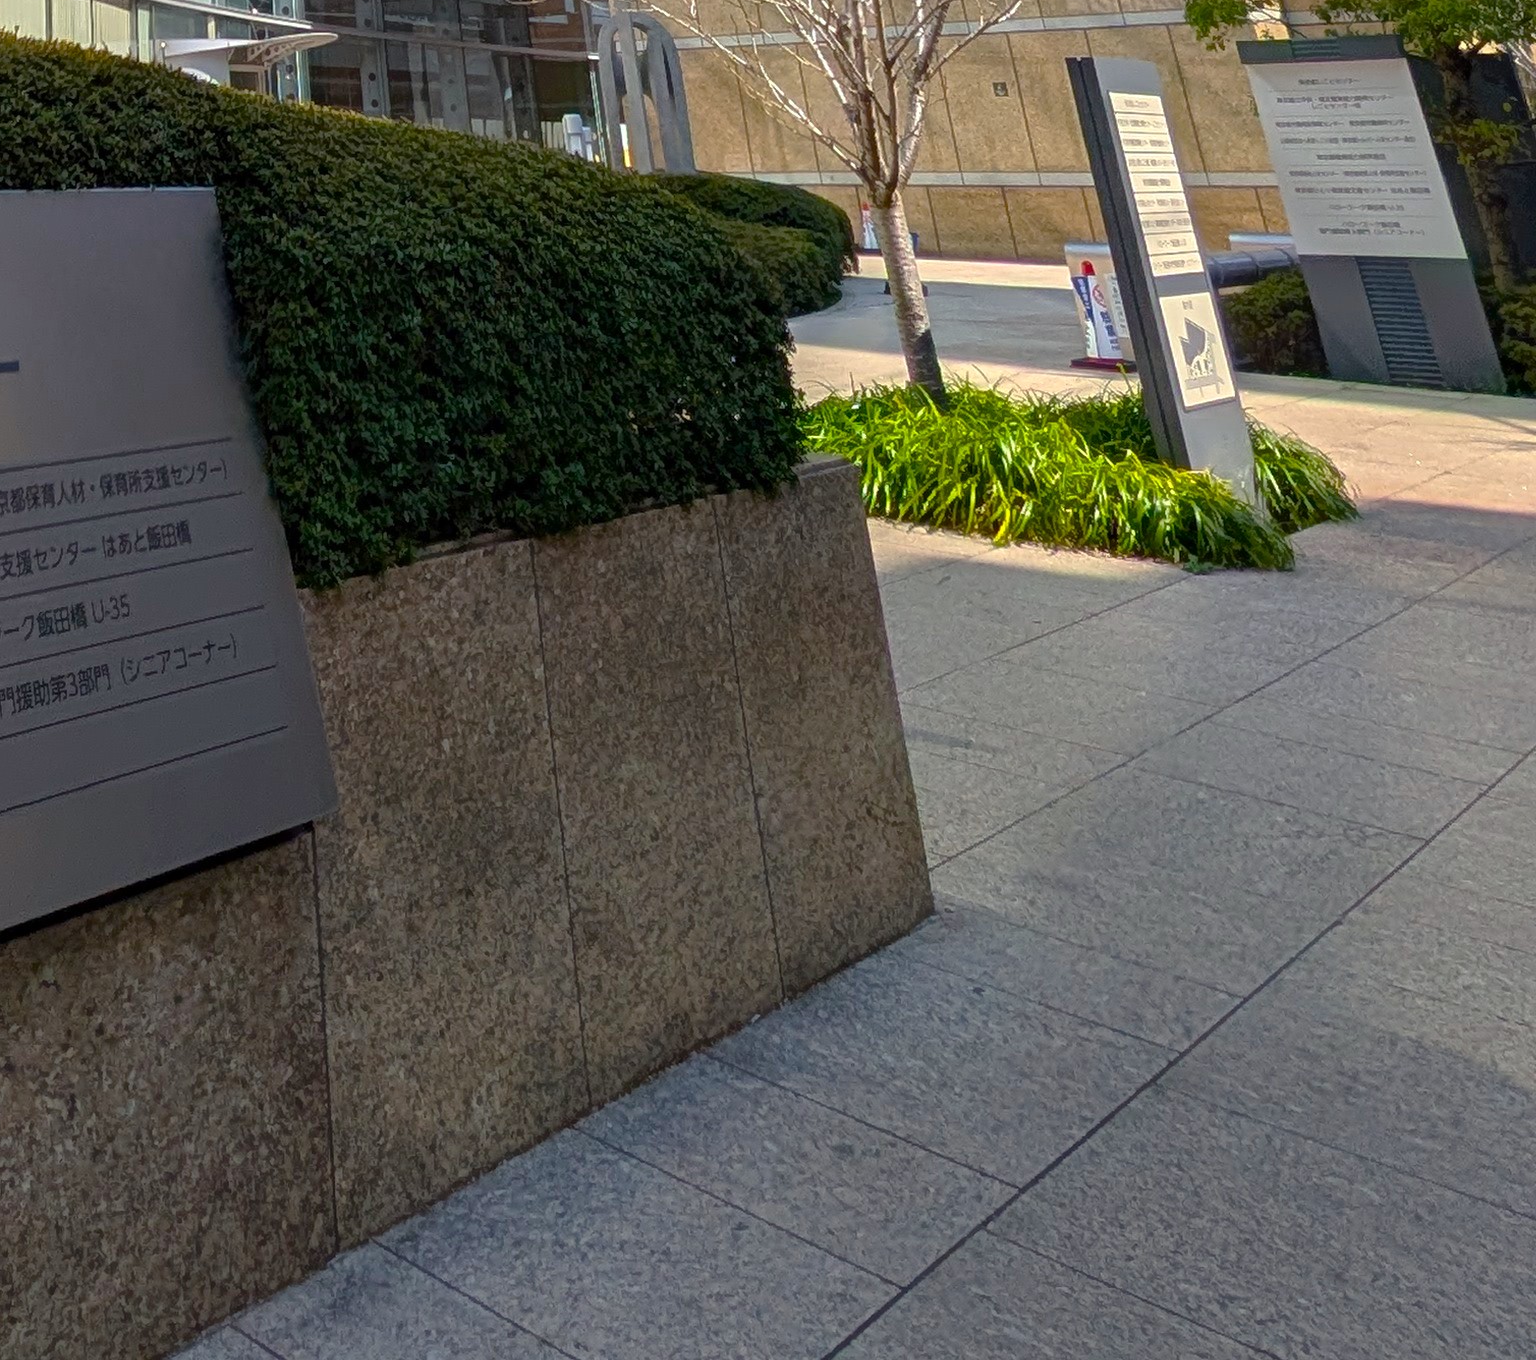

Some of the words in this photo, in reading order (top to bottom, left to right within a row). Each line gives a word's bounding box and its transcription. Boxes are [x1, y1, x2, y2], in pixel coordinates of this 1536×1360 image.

[101, 519, 193, 559] はあと飯田橋
[91, 593, 131, 625] U-35
